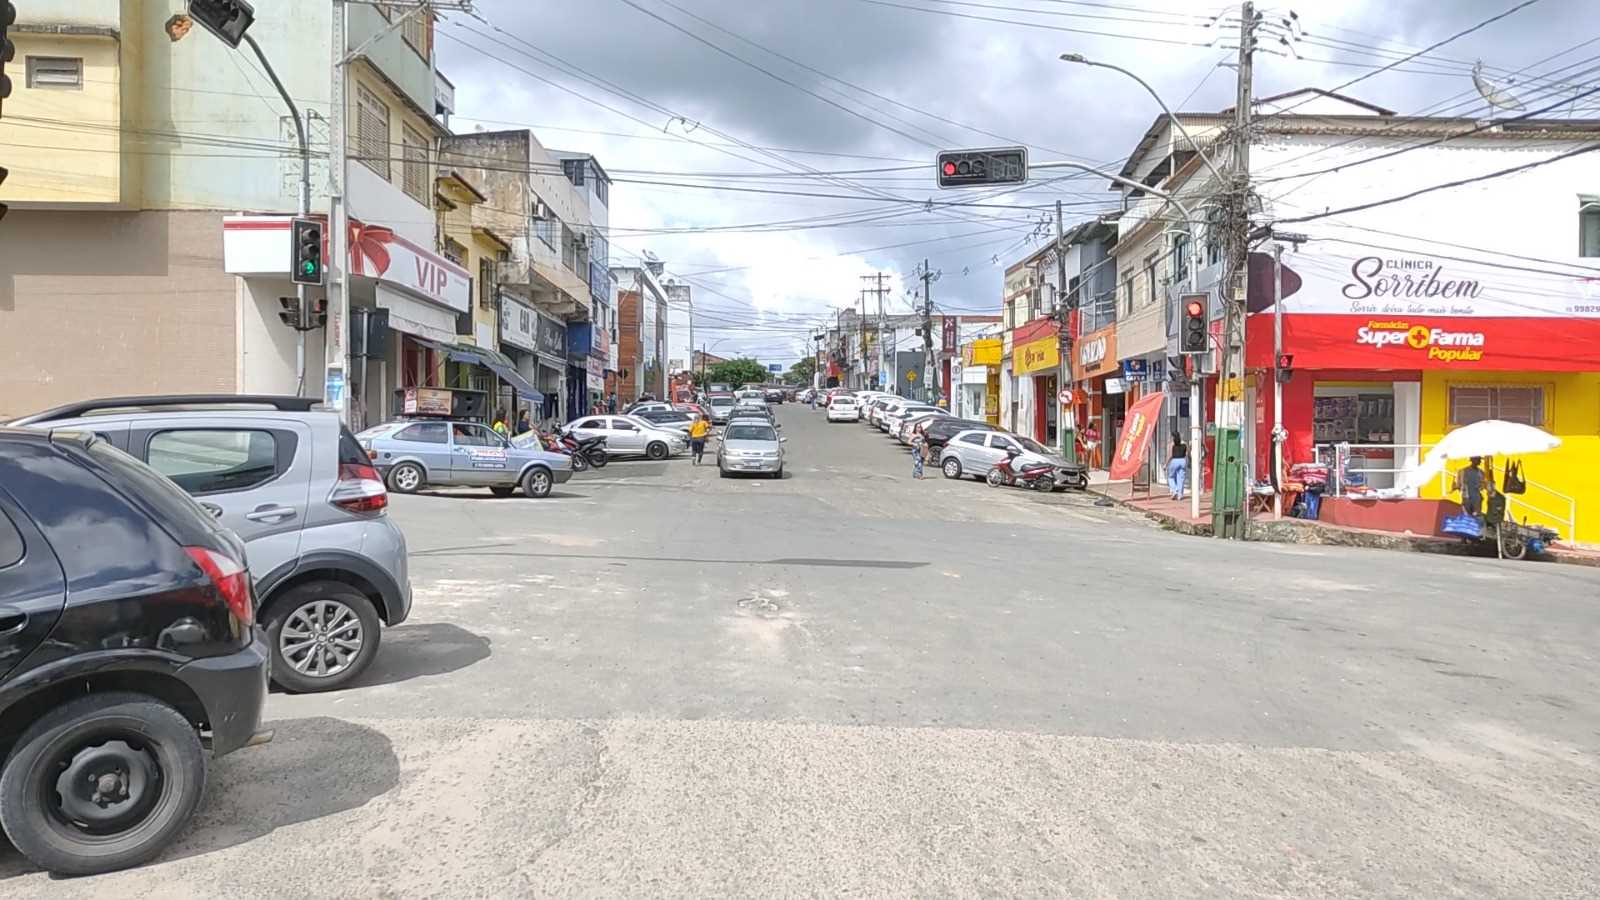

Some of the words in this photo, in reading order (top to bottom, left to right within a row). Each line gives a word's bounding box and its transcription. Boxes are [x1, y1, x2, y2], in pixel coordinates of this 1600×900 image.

[1386, 259, 1432, 269] CLÍNICA
[415, 256, 448, 295] VIP
[1357, 326, 1408, 348] Super
[1429, 328, 1484, 345] Farma
[1428, 347, 1483, 362] Popular
